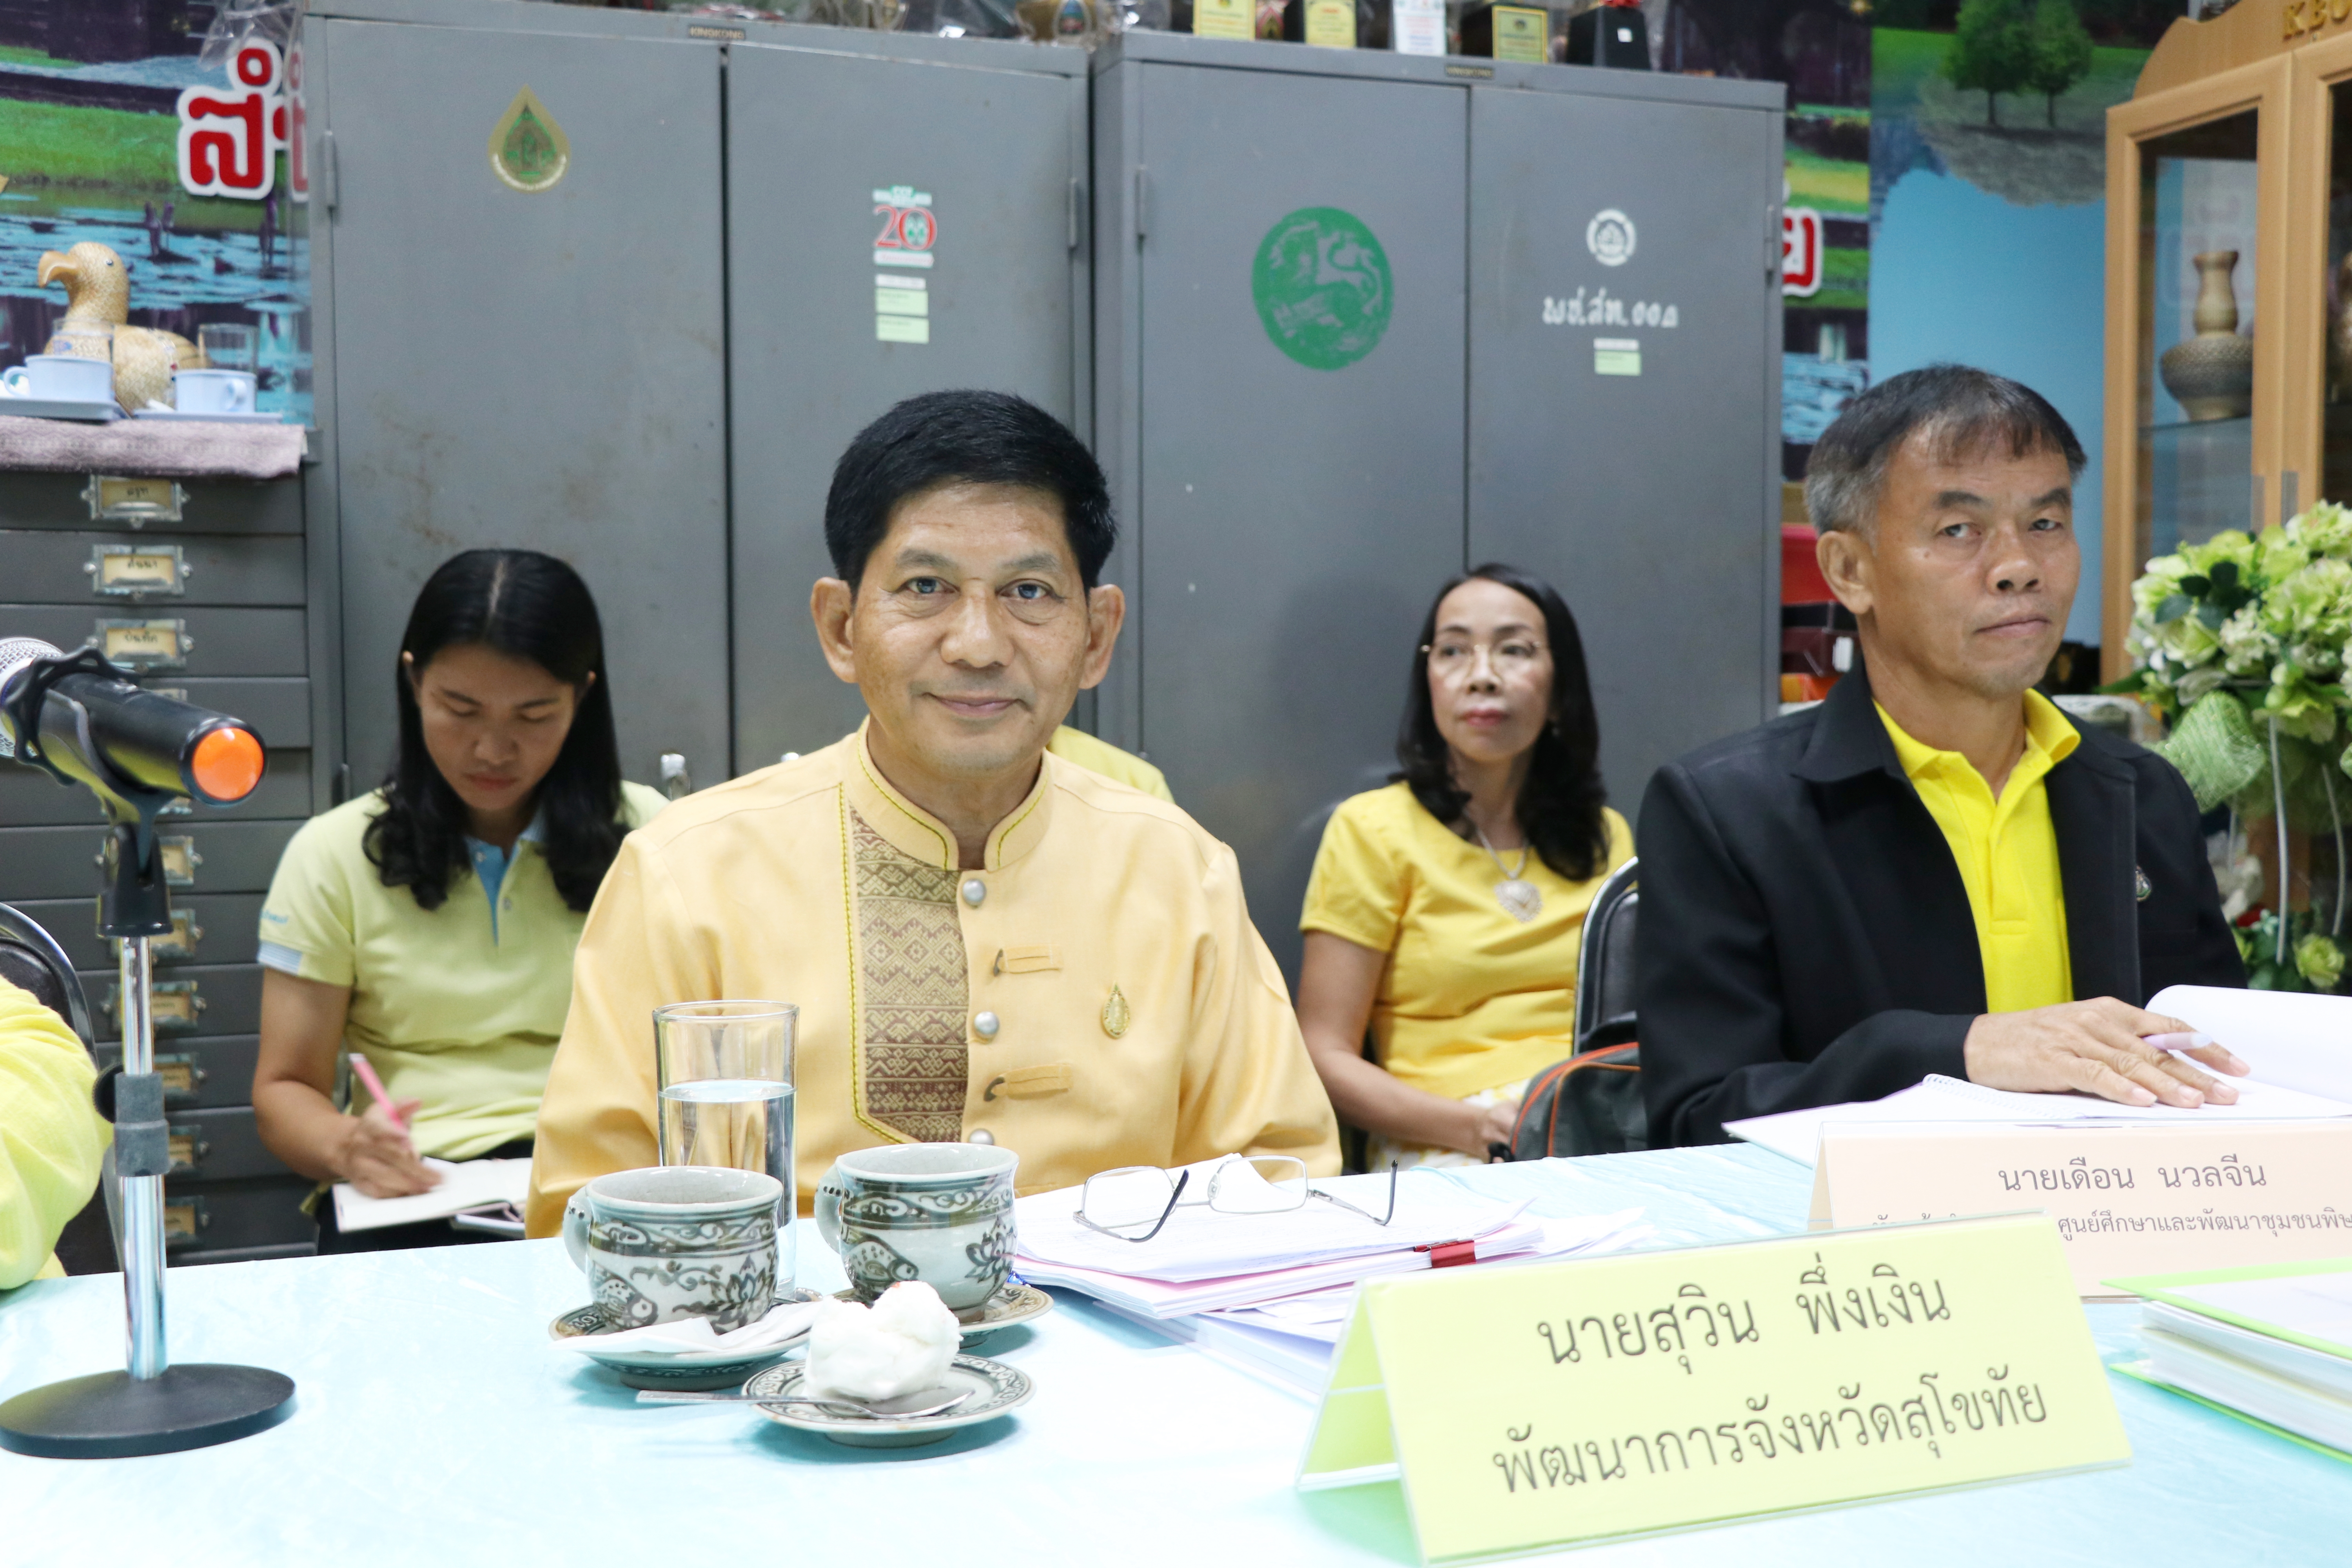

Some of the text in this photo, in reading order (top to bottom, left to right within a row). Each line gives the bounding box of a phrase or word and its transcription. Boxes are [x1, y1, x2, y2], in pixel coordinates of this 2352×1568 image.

[873, 204, 938, 251] 20
[1998, 1153, 2267, 1191] นายเดือน นวลจีน
[1537, 1251, 1951, 1374] นายสุวิน พึ่งเงิน
[1492, 1364, 2047, 1493] พัฒนาการจังหวัดสุโขทัย
